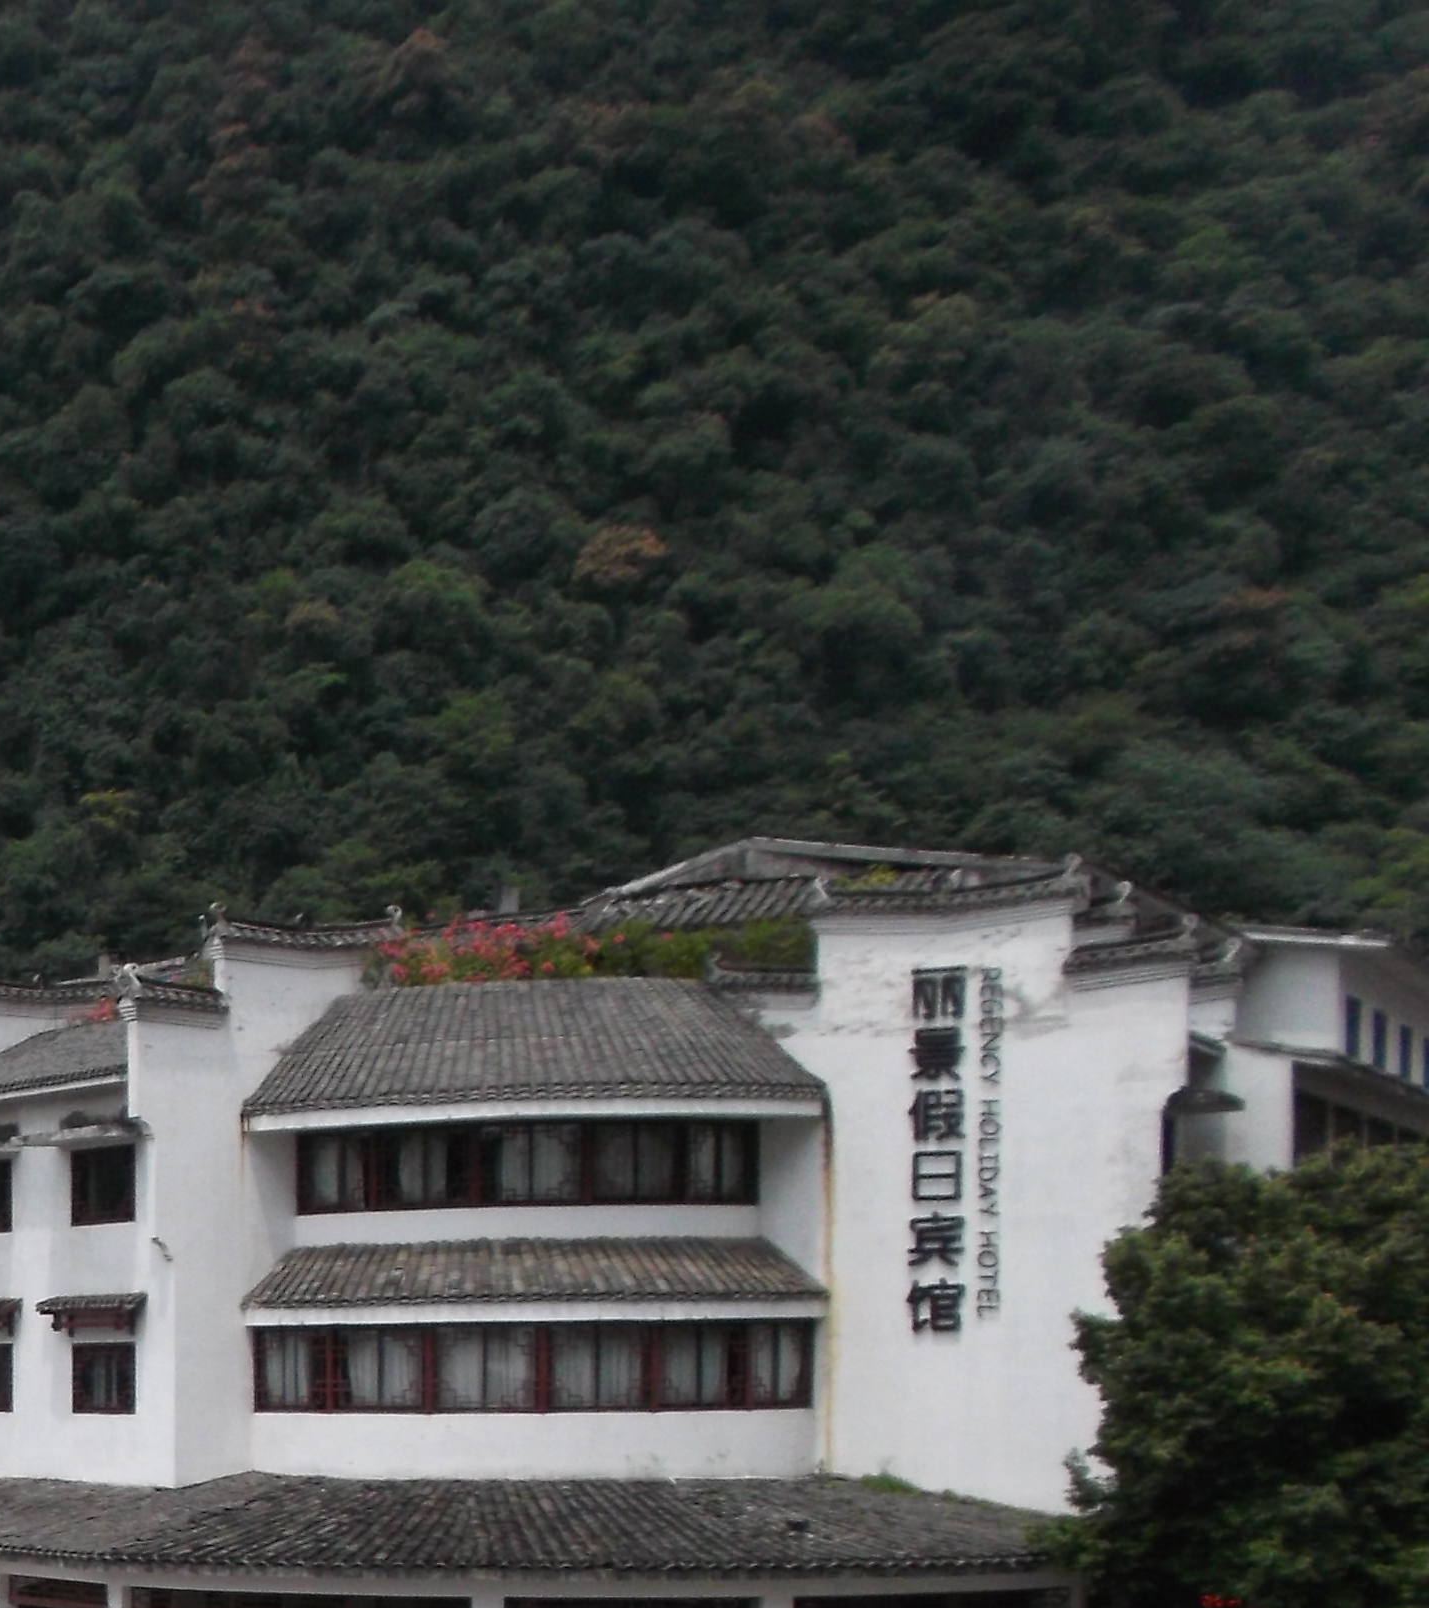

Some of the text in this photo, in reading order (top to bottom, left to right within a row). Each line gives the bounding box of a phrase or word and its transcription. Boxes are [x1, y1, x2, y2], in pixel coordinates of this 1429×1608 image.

[906, 965, 967, 1334] 丽景假日宾馆
[976, 967, 1003, 1321] REGENCY HOLIDAY HOTEL
